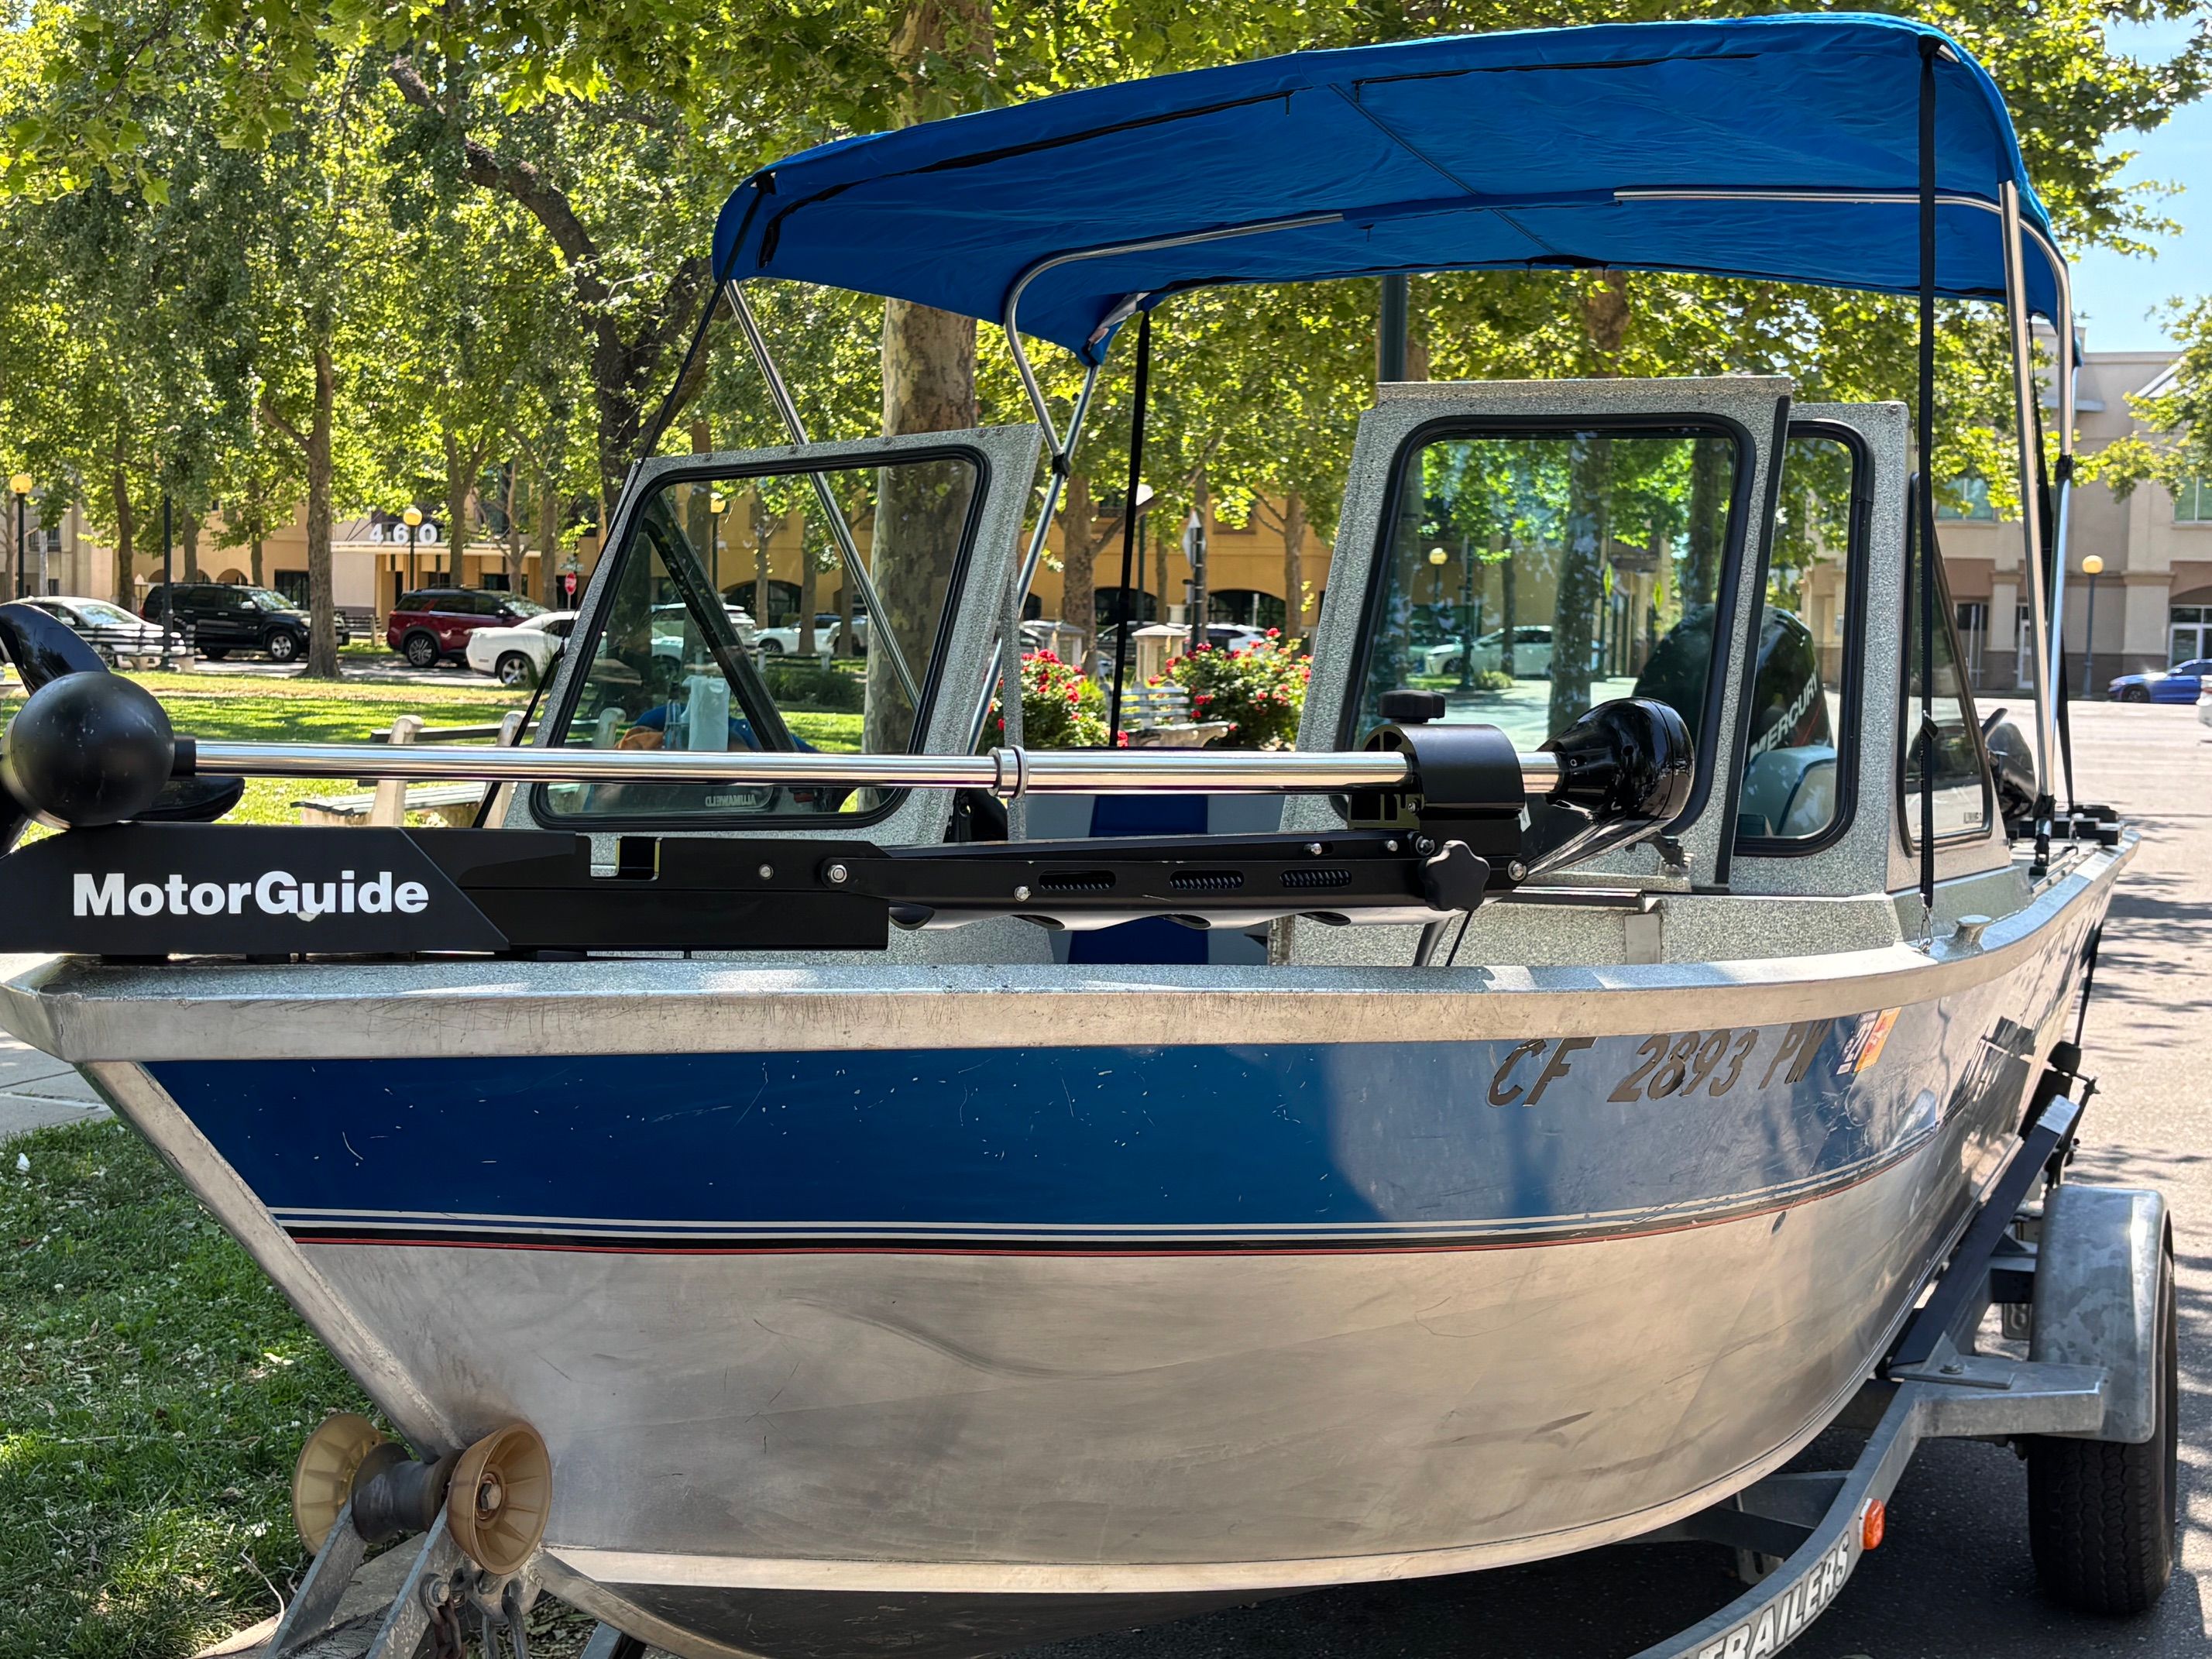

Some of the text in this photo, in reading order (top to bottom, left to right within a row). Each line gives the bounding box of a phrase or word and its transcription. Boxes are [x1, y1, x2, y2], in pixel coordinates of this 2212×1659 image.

[369, 523, 438, 544] 460
[1749, 665, 1818, 763] MERCURY
[74, 870, 429, 917] MotorGuide
[1487, 1036, 1598, 1108] CF
[1606, 1028, 1760, 1103] 2893
